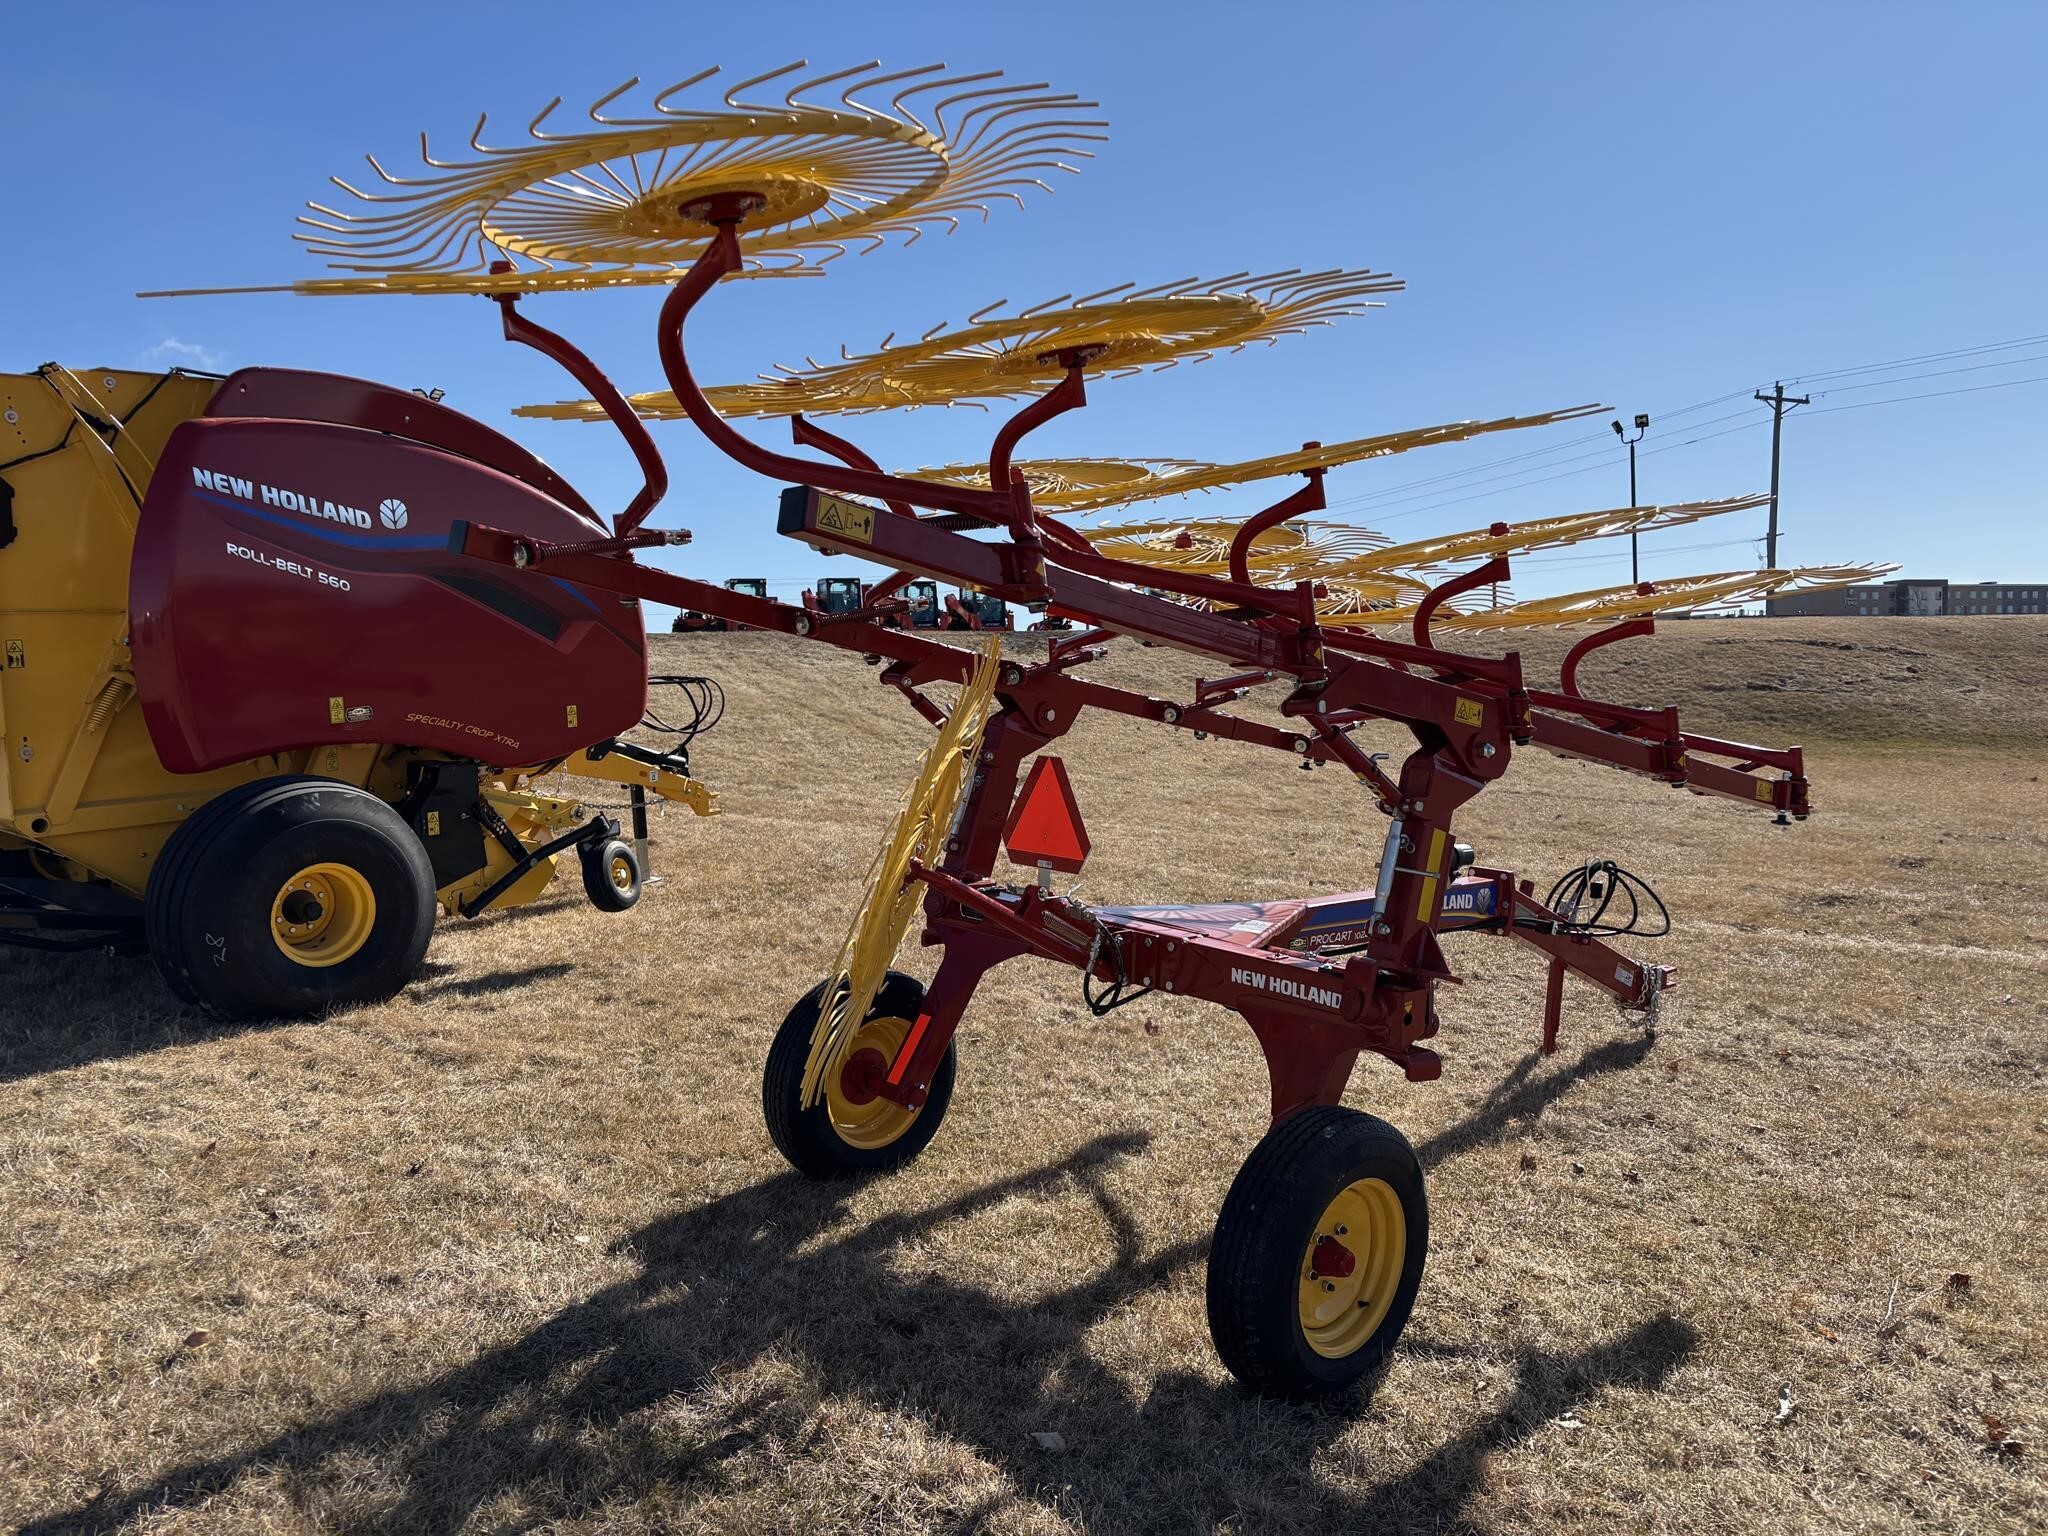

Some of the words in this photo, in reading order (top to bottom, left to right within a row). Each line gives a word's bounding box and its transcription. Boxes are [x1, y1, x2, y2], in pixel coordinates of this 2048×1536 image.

[192, 466, 253, 500] NEW
[261, 484, 372, 530] HOLLAND
[226, 542, 314, 579] ROLL-BELT
[318, 571, 351, 592] 560
[406, 713, 464, 731] SPECIALTY
[465, 725, 494, 738] CROP
[494, 734, 520, 749] XTRA
[1442, 894, 1473, 910] LAND
[1310, 930, 1353, 946] PROCART
[1231, 967, 1266, 989] NEW
[1269, 976, 1342, 1009] HOLLAND
